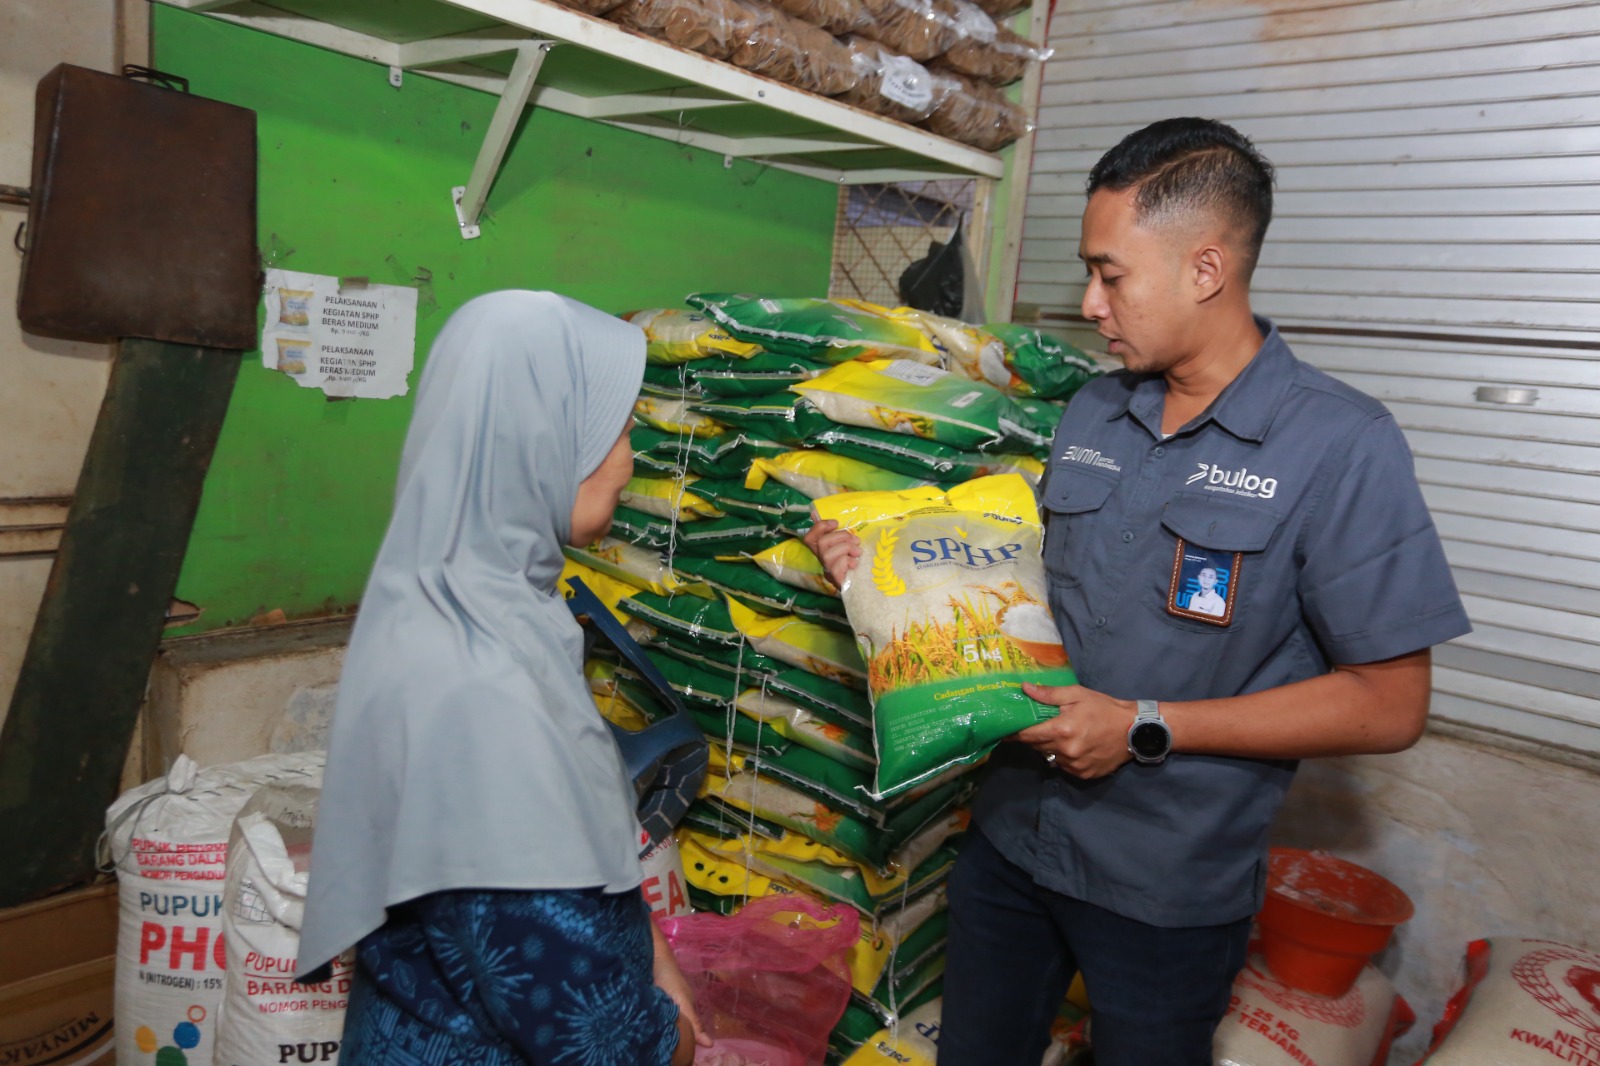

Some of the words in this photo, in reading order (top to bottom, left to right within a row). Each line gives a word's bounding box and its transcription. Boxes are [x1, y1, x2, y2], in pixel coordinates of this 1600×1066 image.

[325, 296, 378, 309] PELAKSANAAN
[323, 308, 361, 319] KEGIATAN
[361, 312, 380, 321] SPHP
[322, 318, 346, 327] BERAS
[347, 320, 379, 330] MEDIUM
[321, 345, 374, 356] PELAKSANAAN
[319, 366, 343, 375] BERAS
[358, 360, 377, 368] SPHP
[1208, 463, 1278, 499] bulog
[910, 537, 1023, 566] SPHP
[963, 643, 980, 662] 5
[981, 648, 1003, 662] kg
[934, 686, 975, 701] Cadangan
[136, 853, 185, 867] BARANG
[174, 870, 227, 881] PENGADU
[146, 972, 195, 991] (NITROGEN)
[203, 977, 223, 990] 15%
[247, 980, 332, 996] BARANG
[258, 1000, 309, 1014] NOMOR
[311, 999, 349, 1010] PENG
[1253, 1007, 1275, 1022] 25
[1276, 1020, 1301, 1041] KG
[4, 1010, 101, 1063] MINYAK
[278, 1040, 343, 1064] PUP
